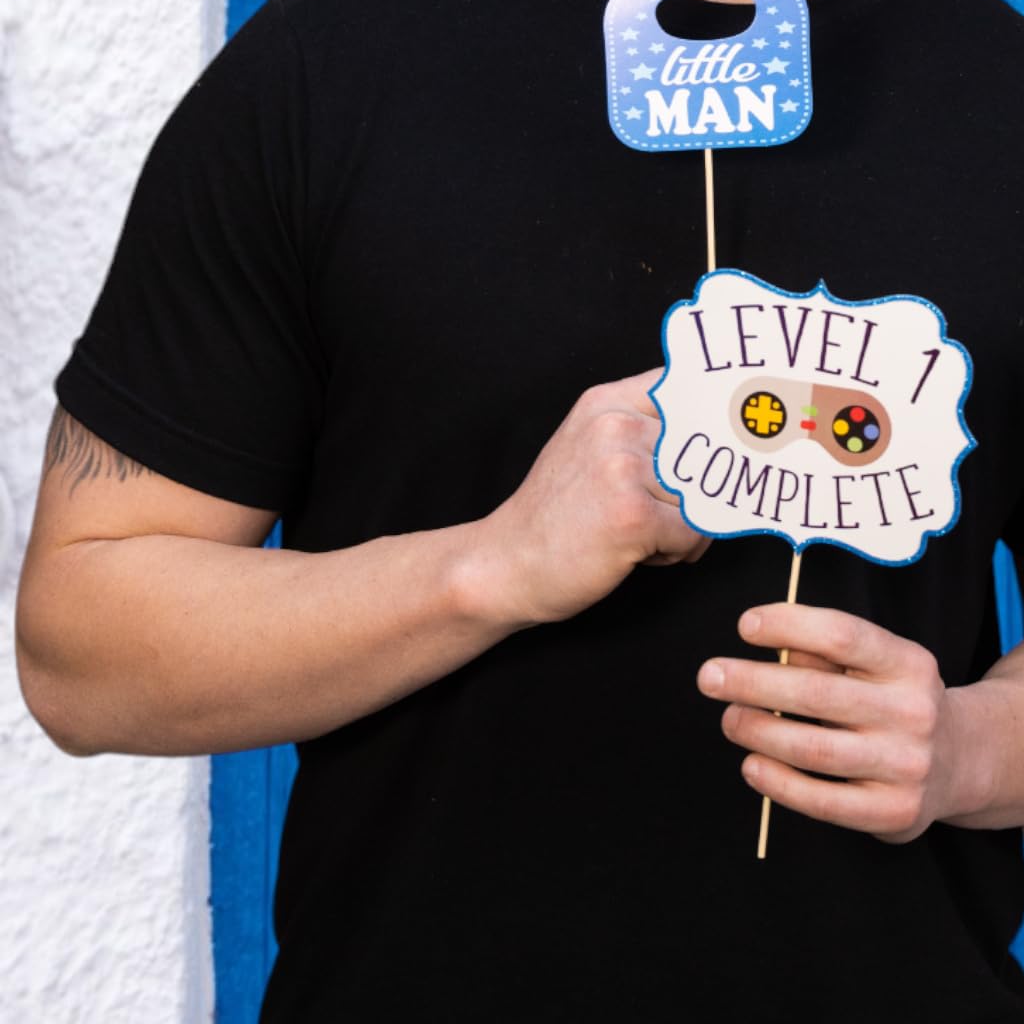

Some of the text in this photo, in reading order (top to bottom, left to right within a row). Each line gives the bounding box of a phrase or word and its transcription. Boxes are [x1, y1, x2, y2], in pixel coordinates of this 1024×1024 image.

[660, 43, 761, 86] little
[644, 84, 777, 137] MAN
[689, 304, 941, 404] LEVEL 1
[673, 432, 935, 529] COMPLETE
